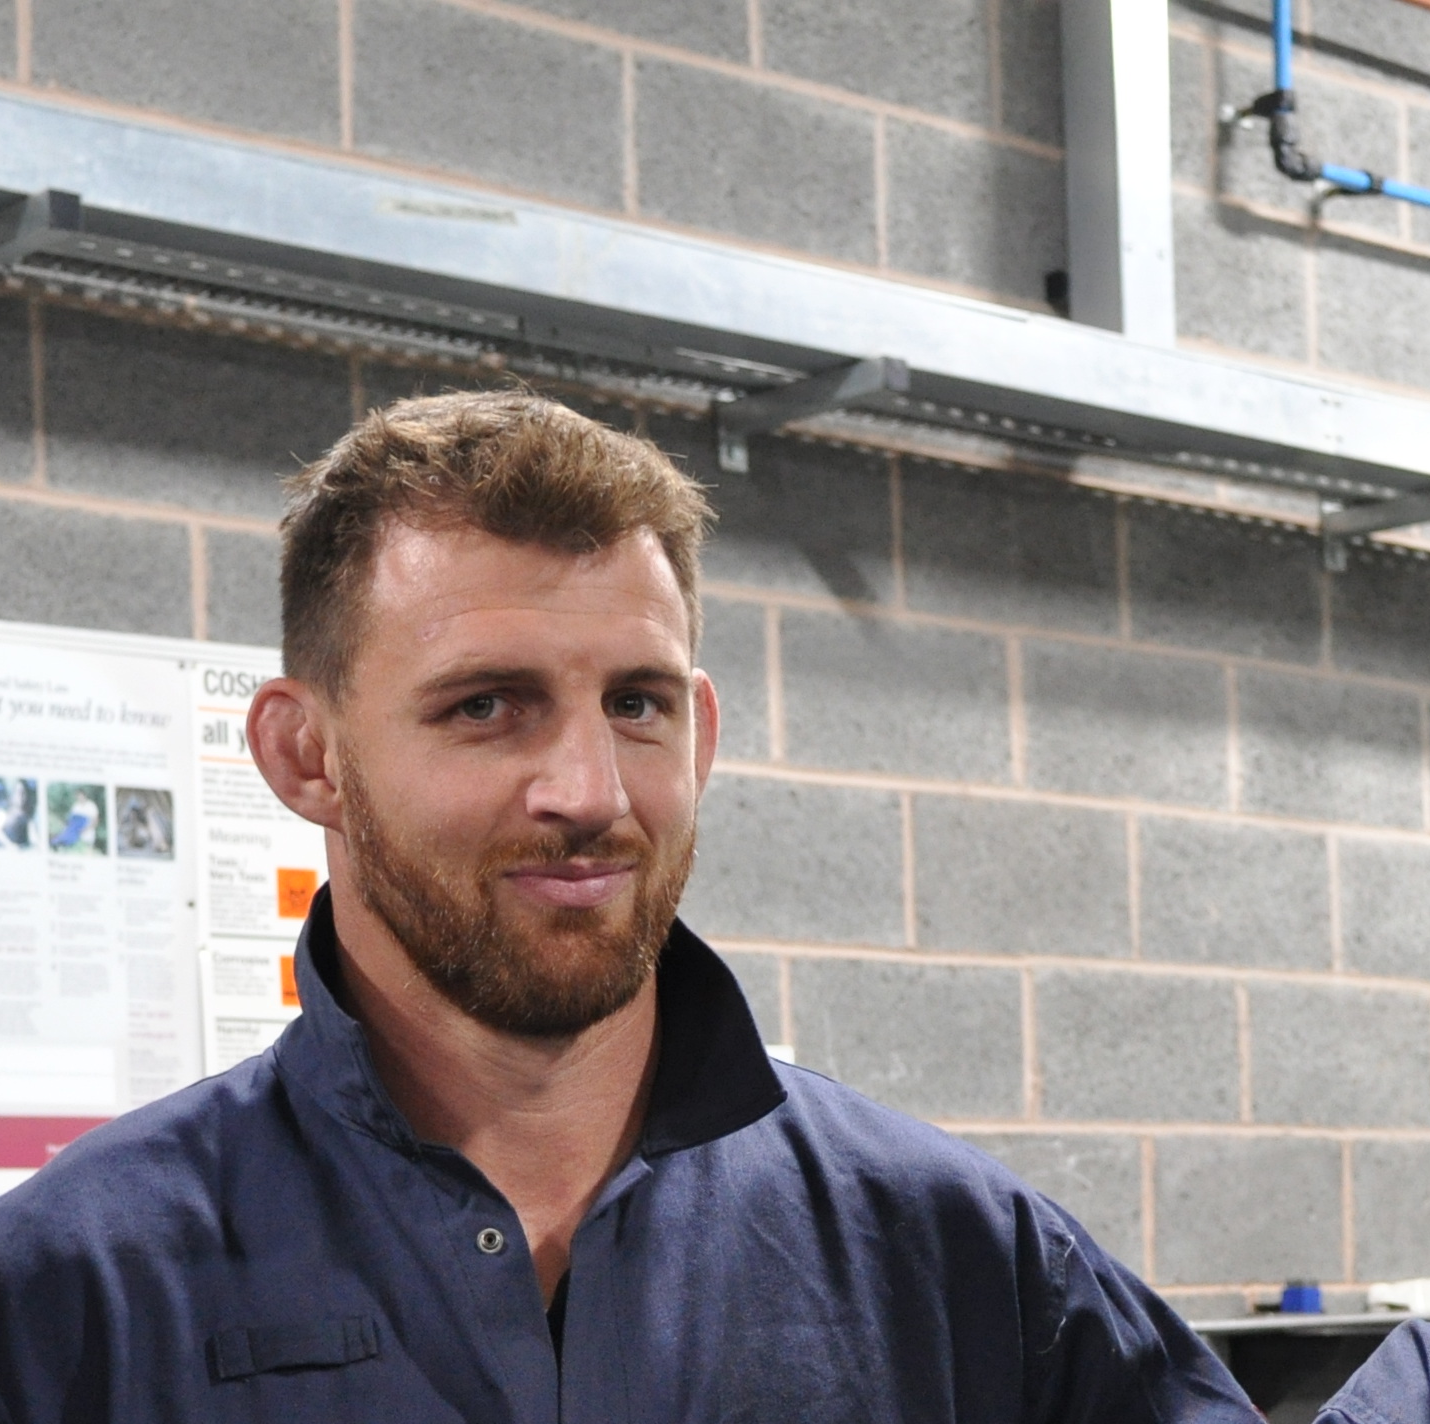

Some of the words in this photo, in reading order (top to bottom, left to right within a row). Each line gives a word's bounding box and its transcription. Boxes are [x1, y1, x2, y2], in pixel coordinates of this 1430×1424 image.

[9, 697, 44, 722] you
[48, 696, 93, 722] need
[96, 704, 116, 725] to
[120, 701, 171, 728] know
[202, 719, 229, 746] all
